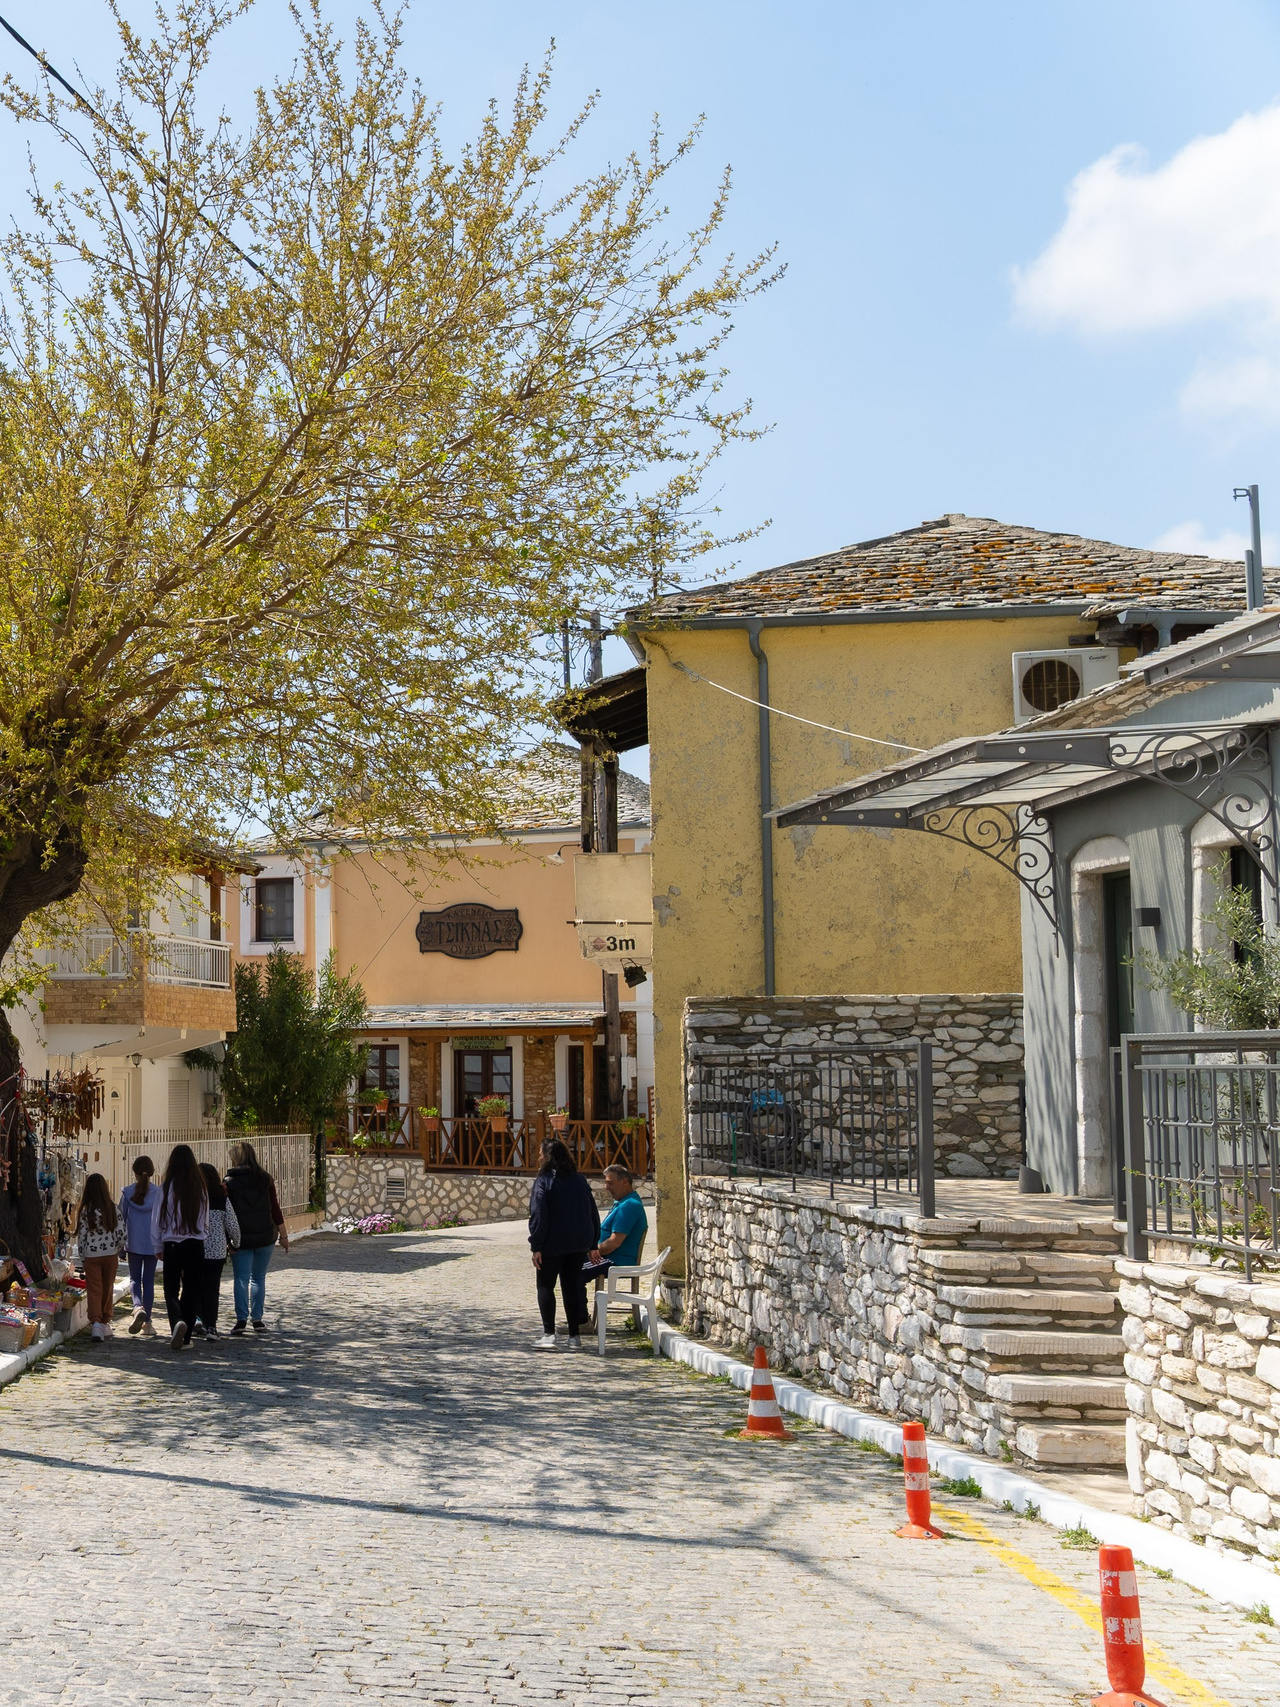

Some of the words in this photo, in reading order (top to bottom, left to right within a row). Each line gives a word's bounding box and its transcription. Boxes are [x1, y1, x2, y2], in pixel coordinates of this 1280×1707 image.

[435, 920, 502, 944] ΤΣΙΚΝΑΣ
[450, 944, 488, 955] ΟΥΖΕΡΙ
[606, 936, 636, 951] 3m
